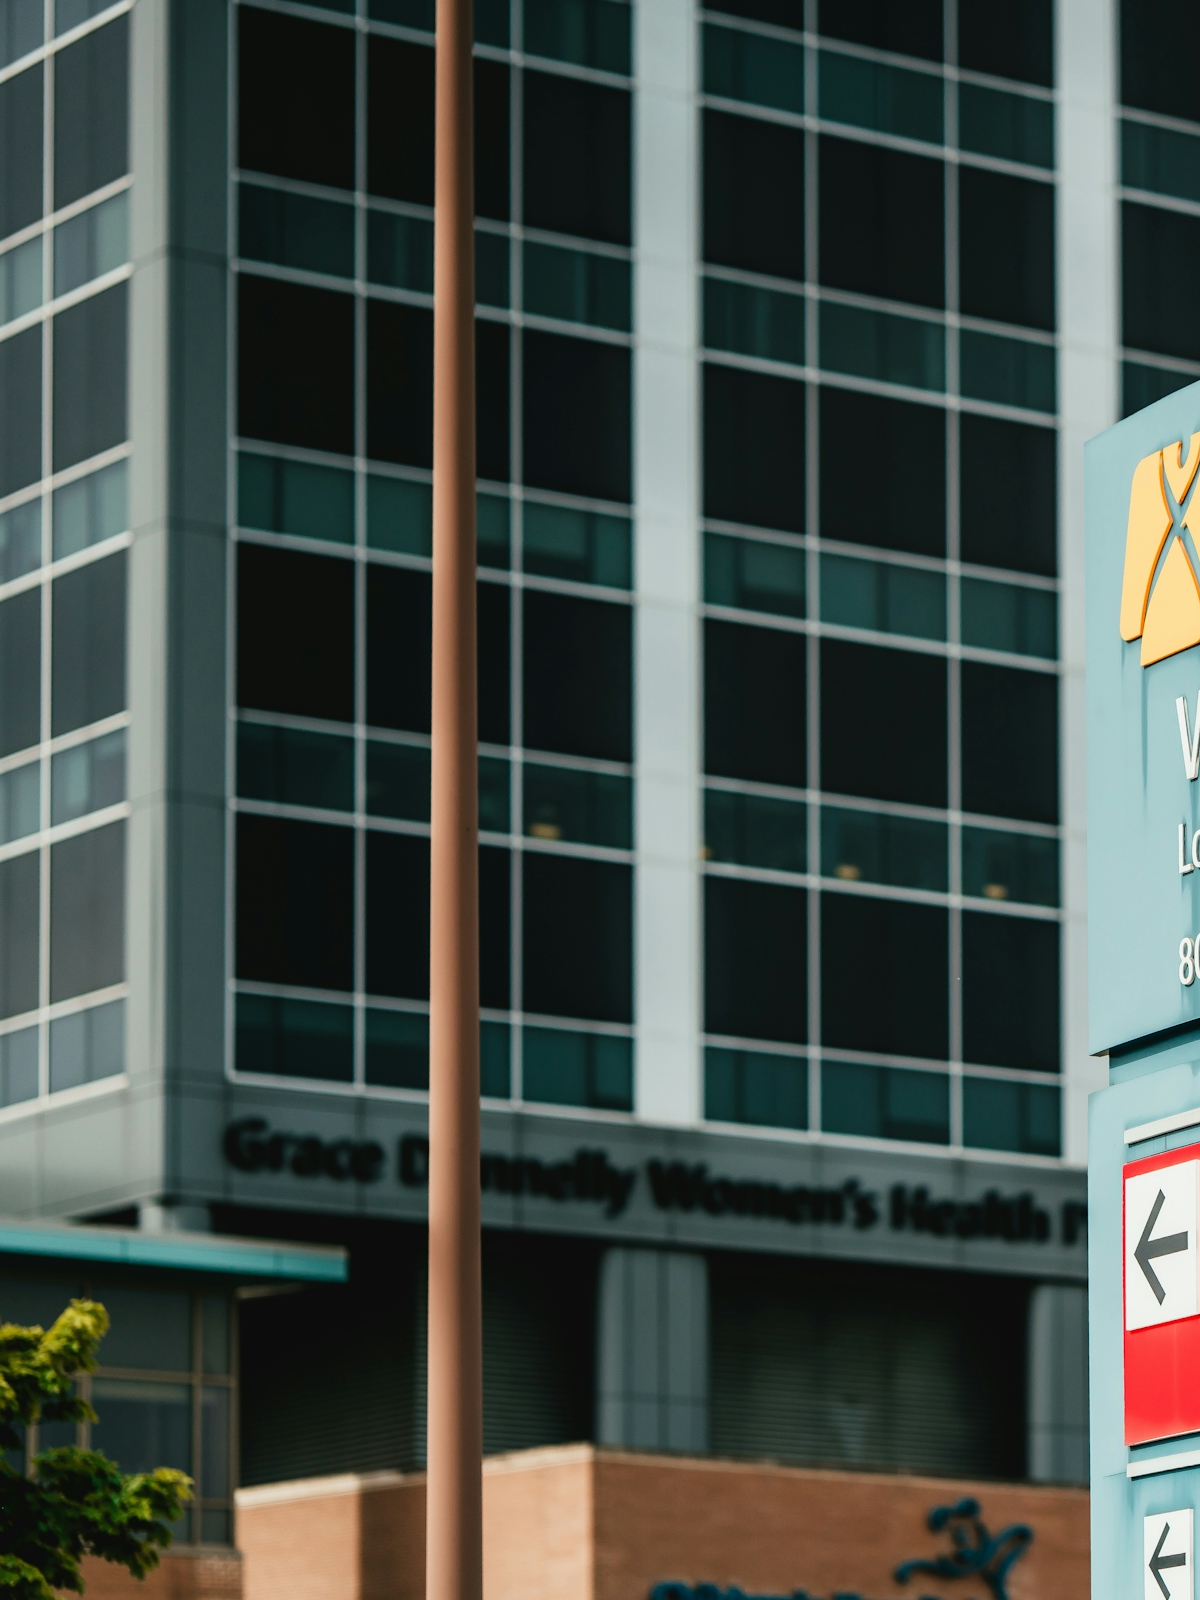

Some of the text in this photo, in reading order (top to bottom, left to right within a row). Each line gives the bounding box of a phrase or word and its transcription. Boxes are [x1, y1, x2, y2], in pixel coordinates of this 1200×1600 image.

[223, 1117, 382, 1183] Grace
[398, 1132, 635, 1219] Dnnelly
[646, 1158, 878, 1231] Women's
[890, 1183, 1050, 1244] Health
